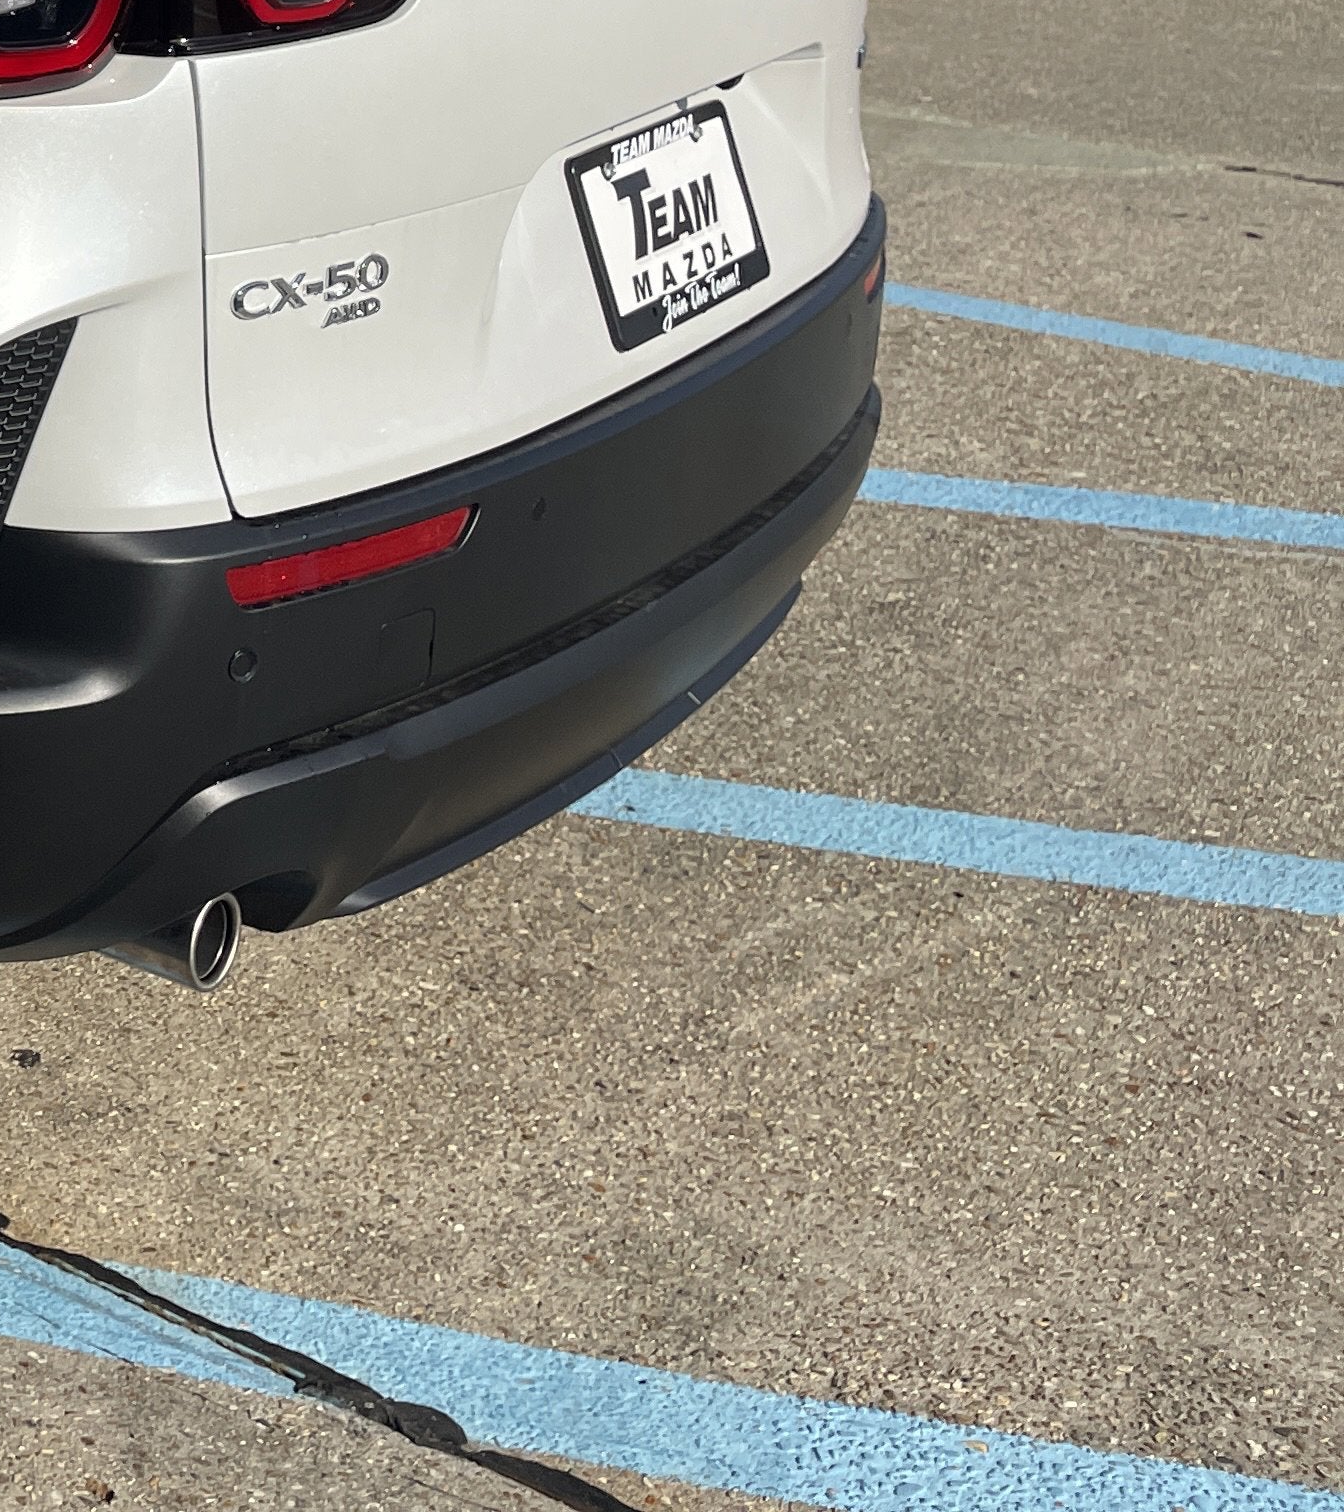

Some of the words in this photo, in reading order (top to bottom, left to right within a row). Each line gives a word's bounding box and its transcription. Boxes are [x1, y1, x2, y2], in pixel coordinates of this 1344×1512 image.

[611, 131, 650, 165] TEAM
[653, 113, 694, 151] MAZDA
[612, 168, 719, 260] TEAM
[230, 253, 389, 320] CX-50
[633, 232, 733, 302] MAZDA
[662, 294, 689, 332] Join
[684, 281, 709, 310] The
[705, 262, 741, 300] Team!
[320, 297, 381, 329] AWD
